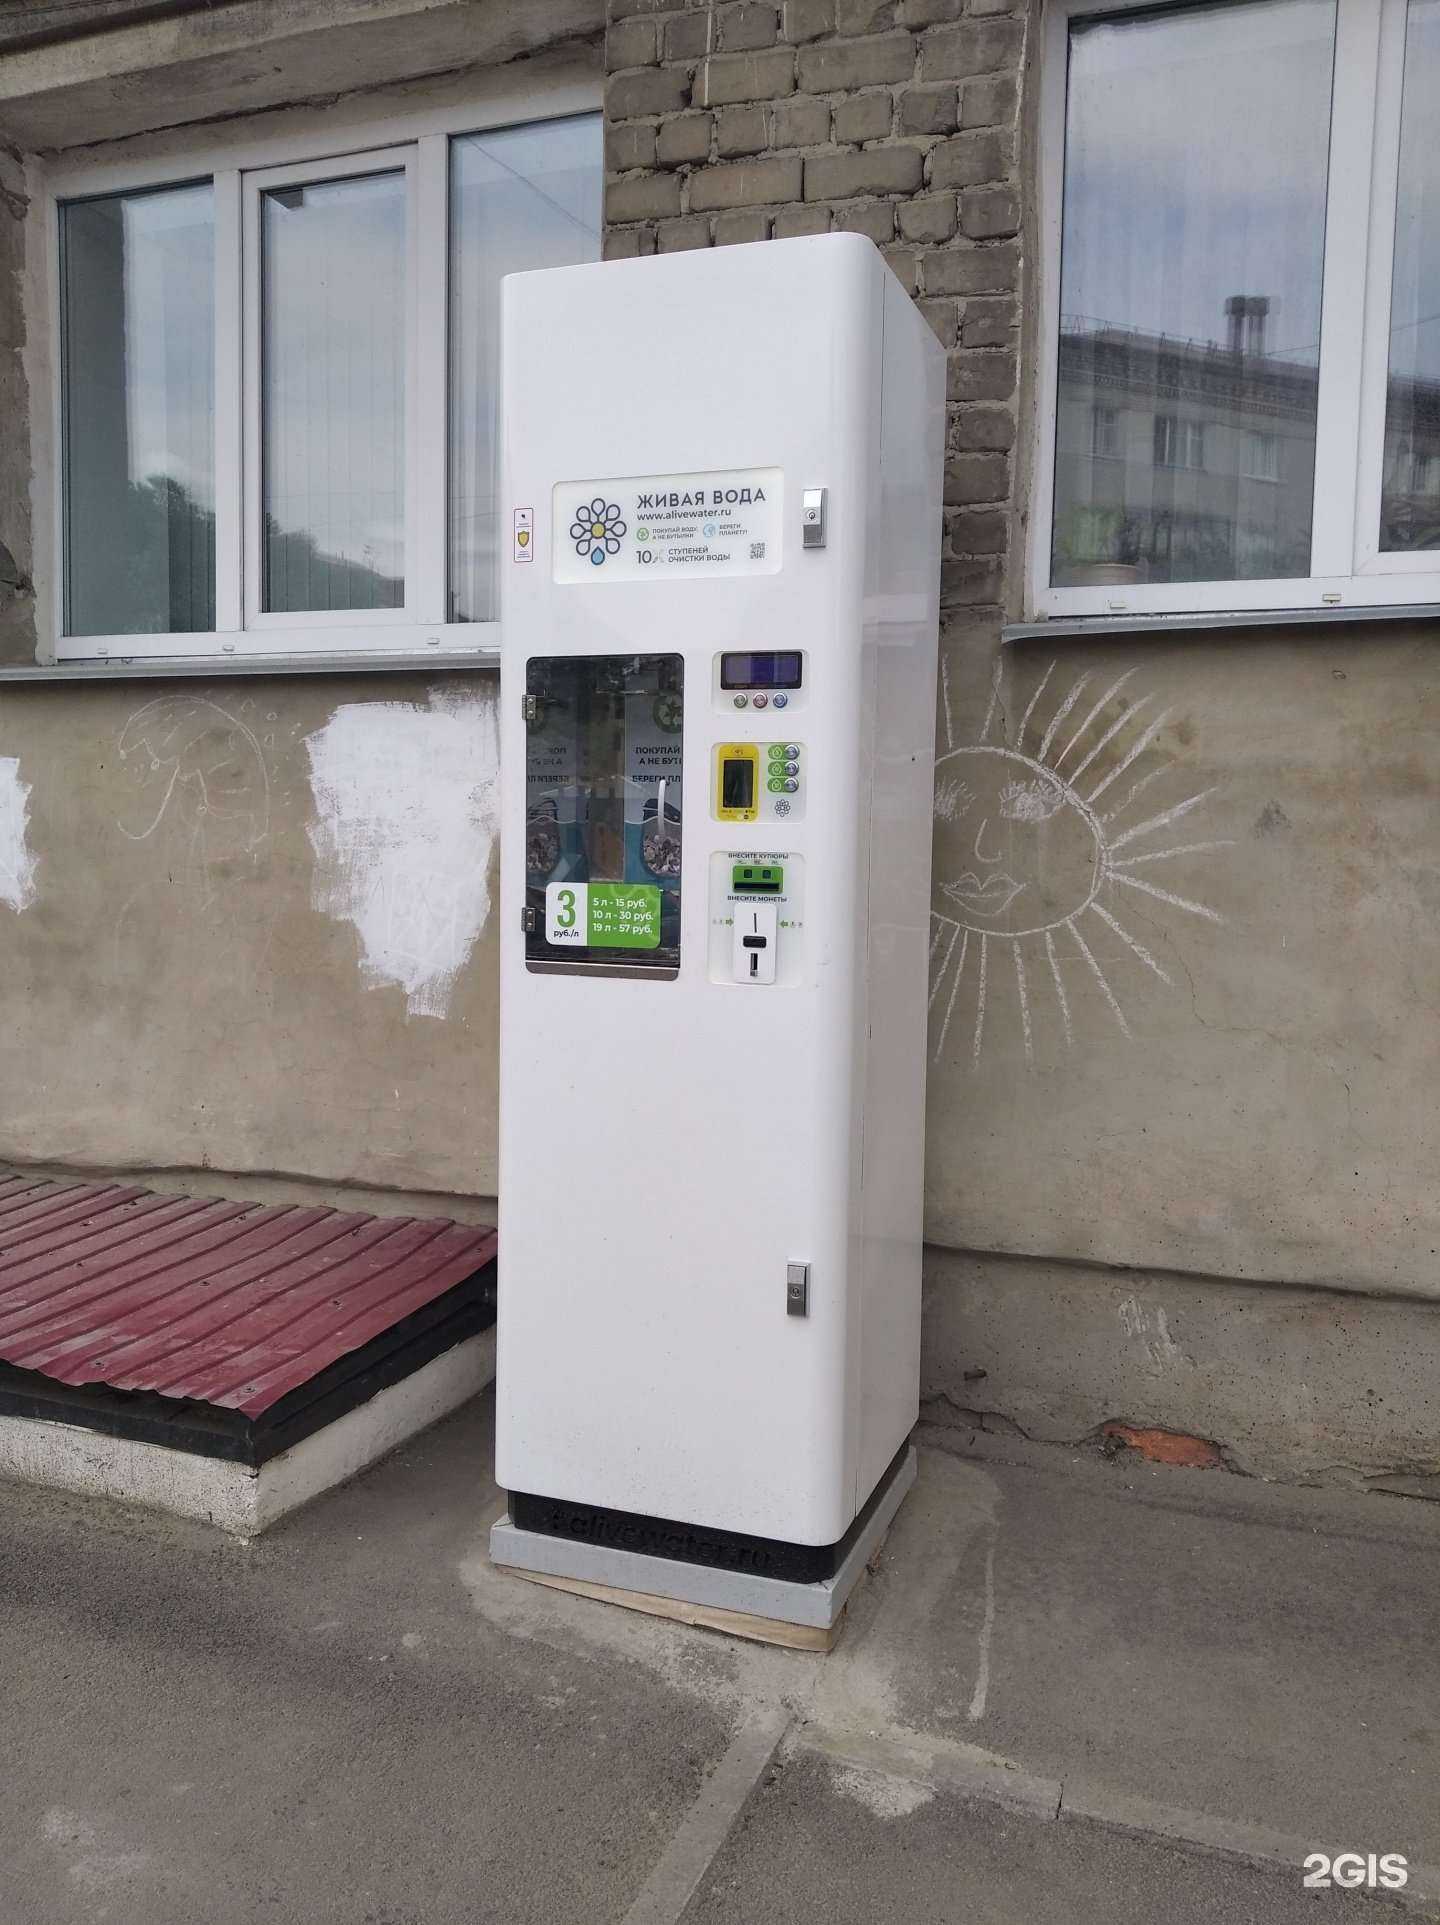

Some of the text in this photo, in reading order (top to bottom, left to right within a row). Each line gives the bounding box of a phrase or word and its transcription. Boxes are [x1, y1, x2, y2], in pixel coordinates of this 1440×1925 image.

[637, 488, 766, 509] ЖИВАЯ ВОДА
[637, 508, 732, 521] www.alivewater.ru
[652, 526, 680, 534] ПОКУПАЙ
[668, 545, 709, 555] СТУПЕНЕЙ
[636, 550, 652, 564] 10
[668, 553, 731, 563] ОЧИСТКИ ВОДЫ
[635, 745, 681, 754] ПОКУПАЙ
[648, 757, 660, 765] НЕ
[728, 851, 757, 859] ВНЕСИТЕ
[557, 889, 576, 928] 3
[593, 898, 599, 906] 5
[615, 898, 625, 907] 15
[627, 899, 648, 909] руб.
[593, 910, 603, 919] 10
[619, 911, 631, 920] 30
[633, 912, 654, 922] руб.
[553, 929, 580, 938] руб./л
[593, 923, 603, 932] 19
[619, 924, 630, 932] 57
[632, 924, 653, 935] руб.
